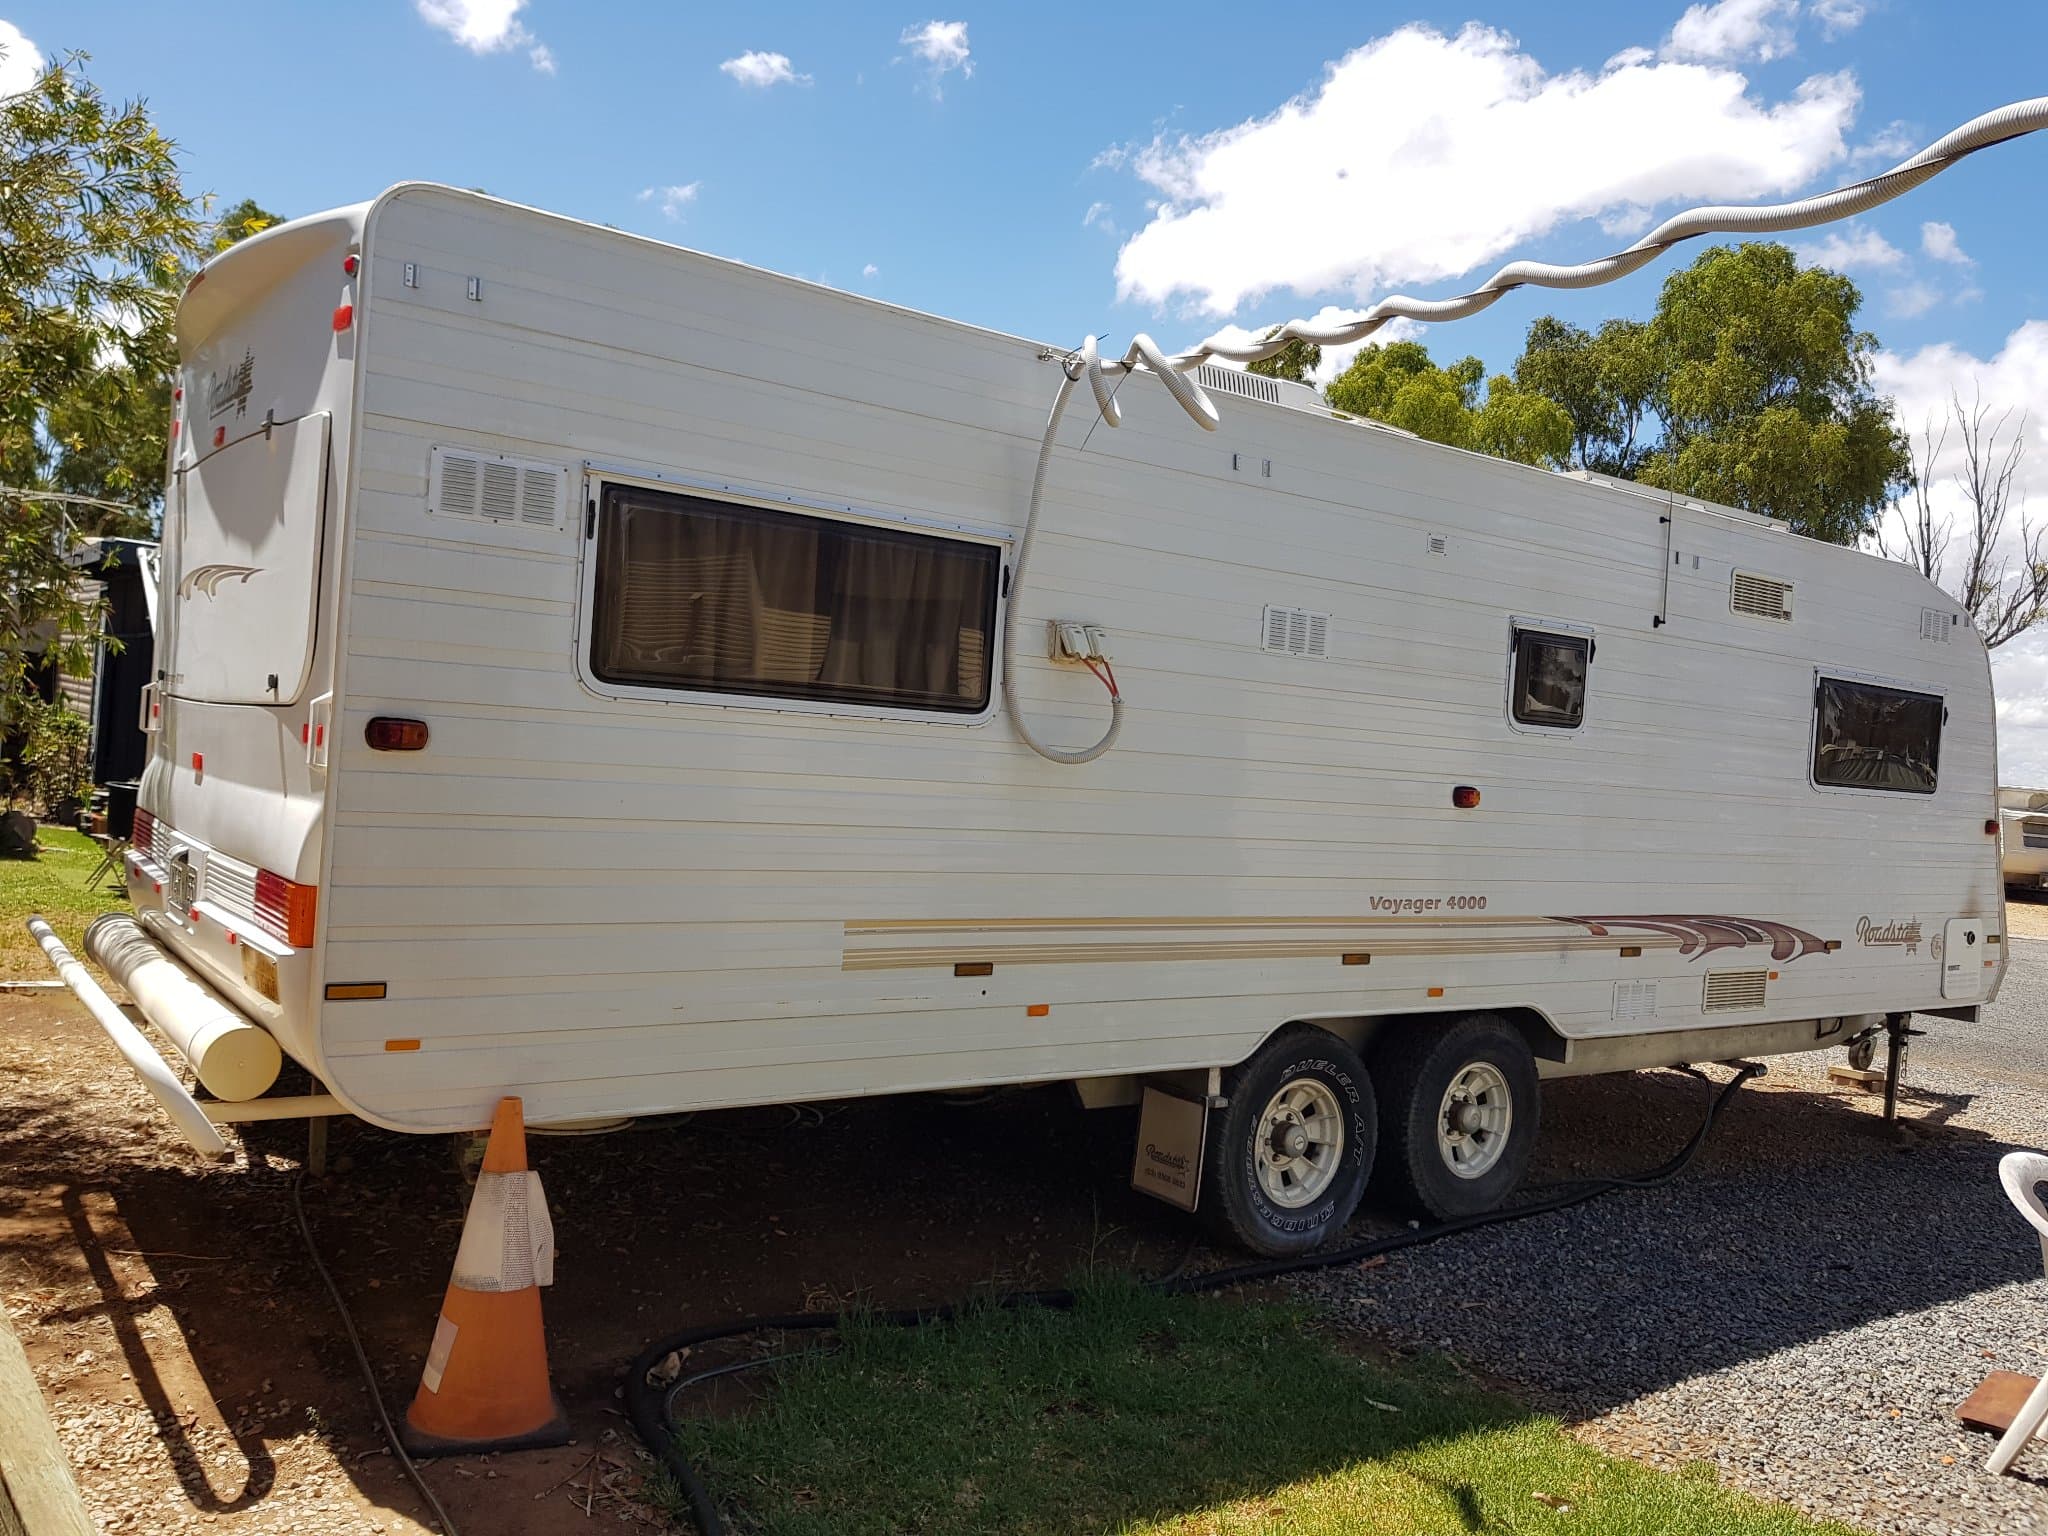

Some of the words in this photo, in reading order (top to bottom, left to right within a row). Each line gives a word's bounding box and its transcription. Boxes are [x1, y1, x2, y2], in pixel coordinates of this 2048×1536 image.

[1369, 896, 1442, 914] Voyager
[1446, 895, 1488, 910] 4000
[1280, 1059, 1360, 1104] DUELER
[1354, 1112, 1367, 1167] A/T
